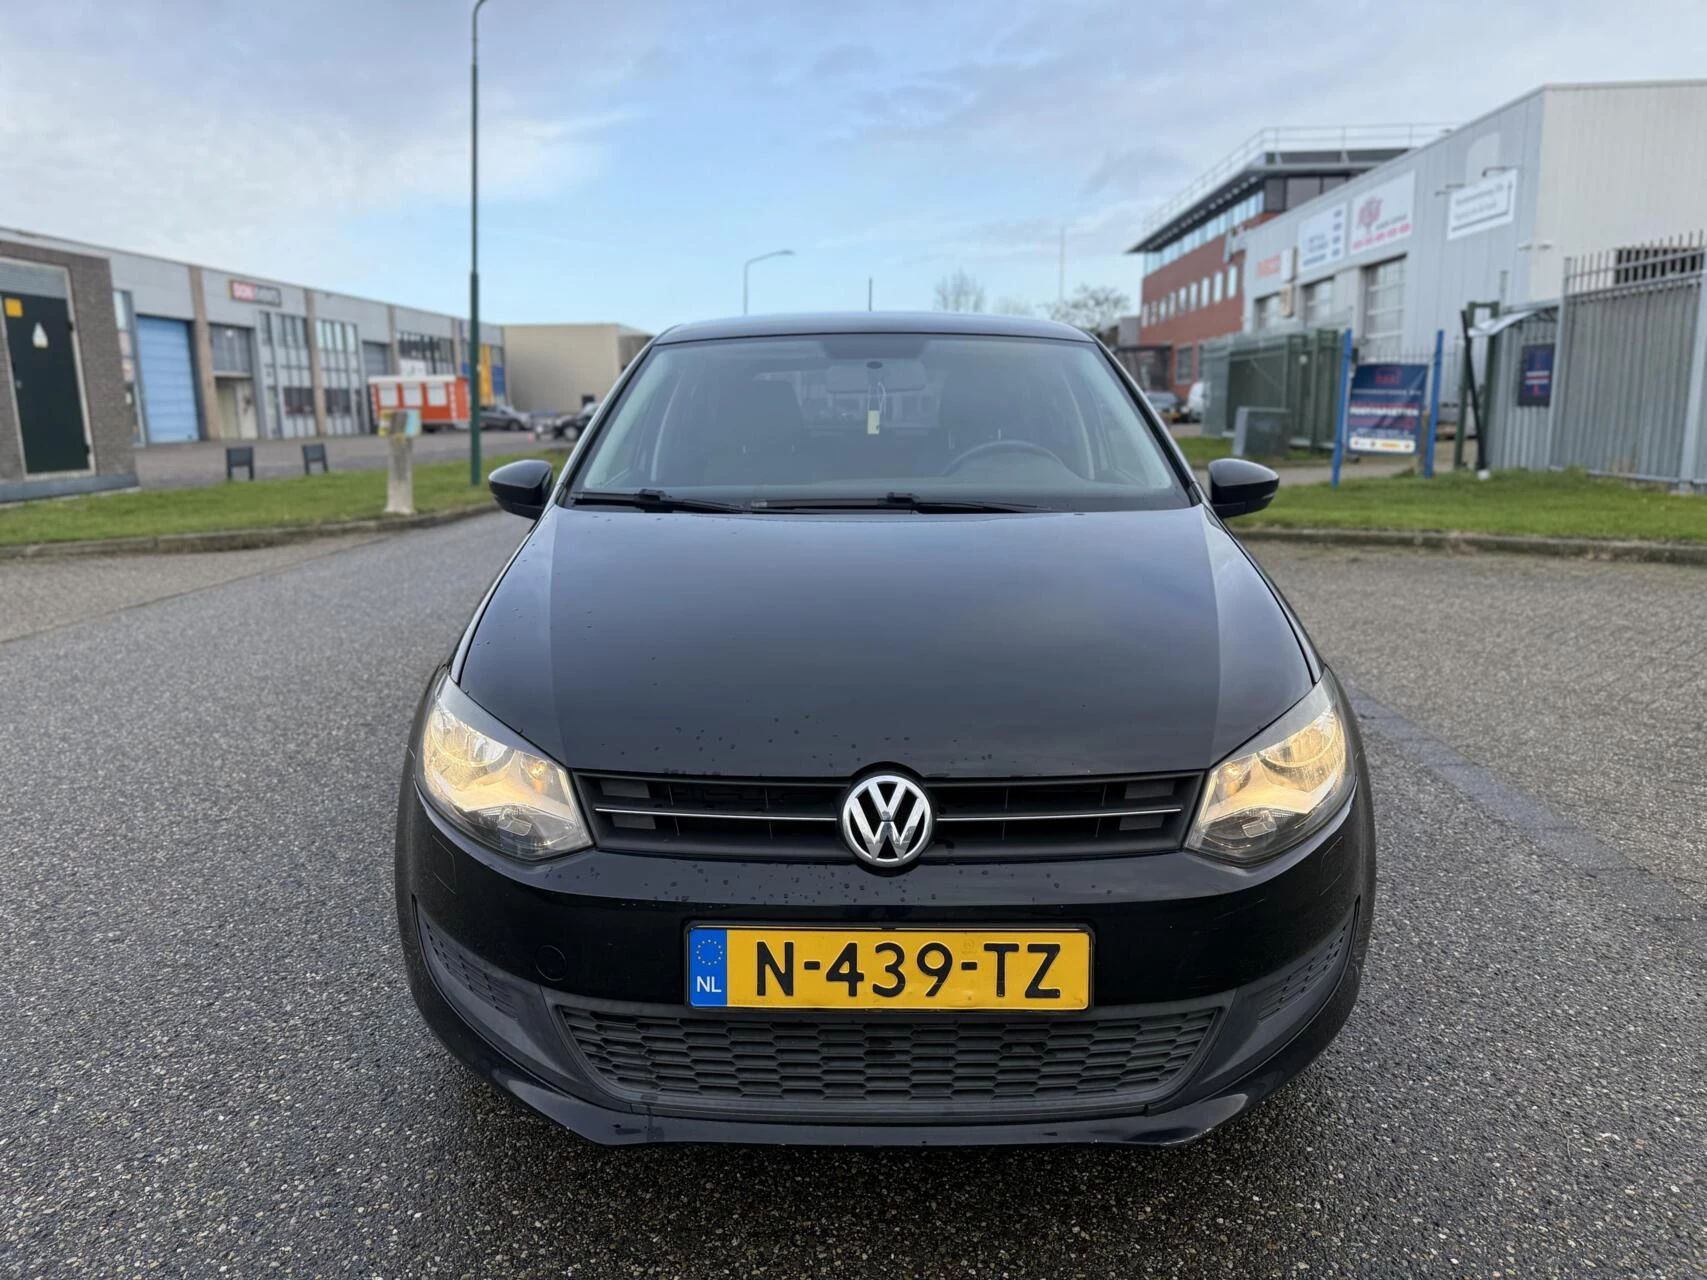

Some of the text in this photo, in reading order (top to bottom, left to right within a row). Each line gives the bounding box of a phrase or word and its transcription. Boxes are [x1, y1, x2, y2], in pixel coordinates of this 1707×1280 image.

[845, 777, 929, 864] VW
[696, 975, 722, 993] NL
[756, 941, 1061, 998] N-439-TZ
